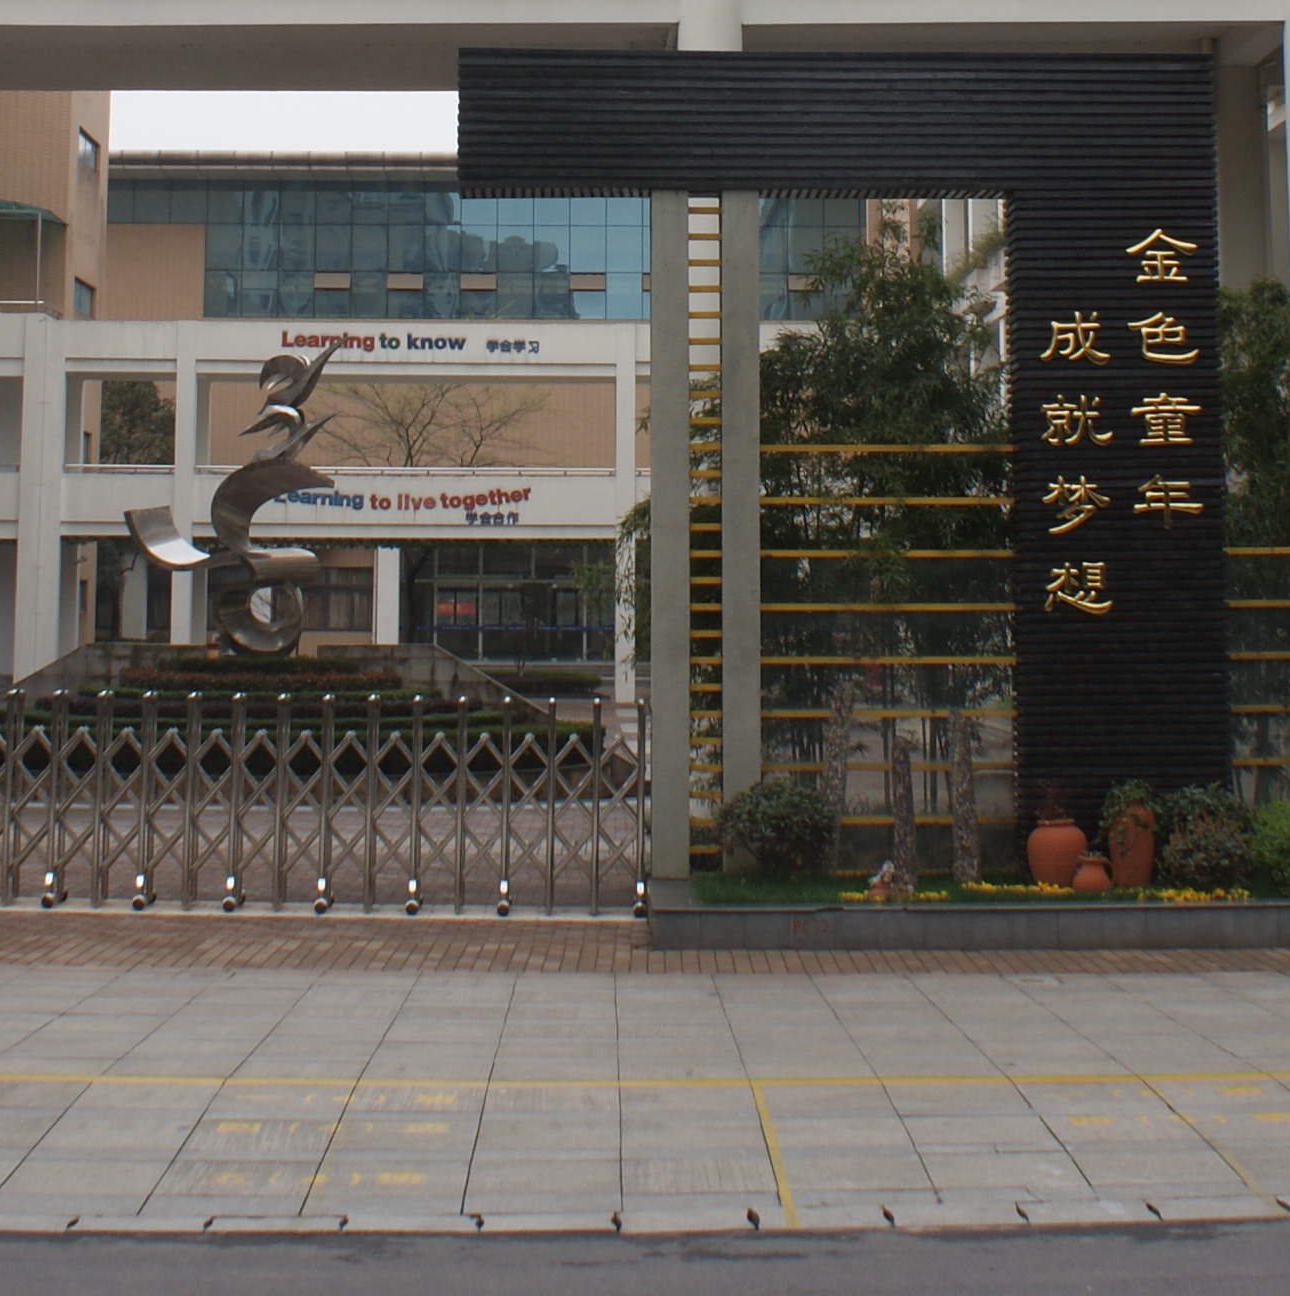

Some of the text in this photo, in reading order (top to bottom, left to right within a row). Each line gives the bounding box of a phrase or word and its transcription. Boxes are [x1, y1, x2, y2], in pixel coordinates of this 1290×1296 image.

[282, 330, 466, 352] Learning to know
[486, 339, 540, 354] 学会学习
[1126, 228, 1204, 531] 金色童年
[1040, 311, 1113, 615] 成就梦想
[370, 493, 392, 510] to
[397, 493, 436, 510] live
[440, 487, 532, 512] together
[466, 511, 520, 526] 学会合作
